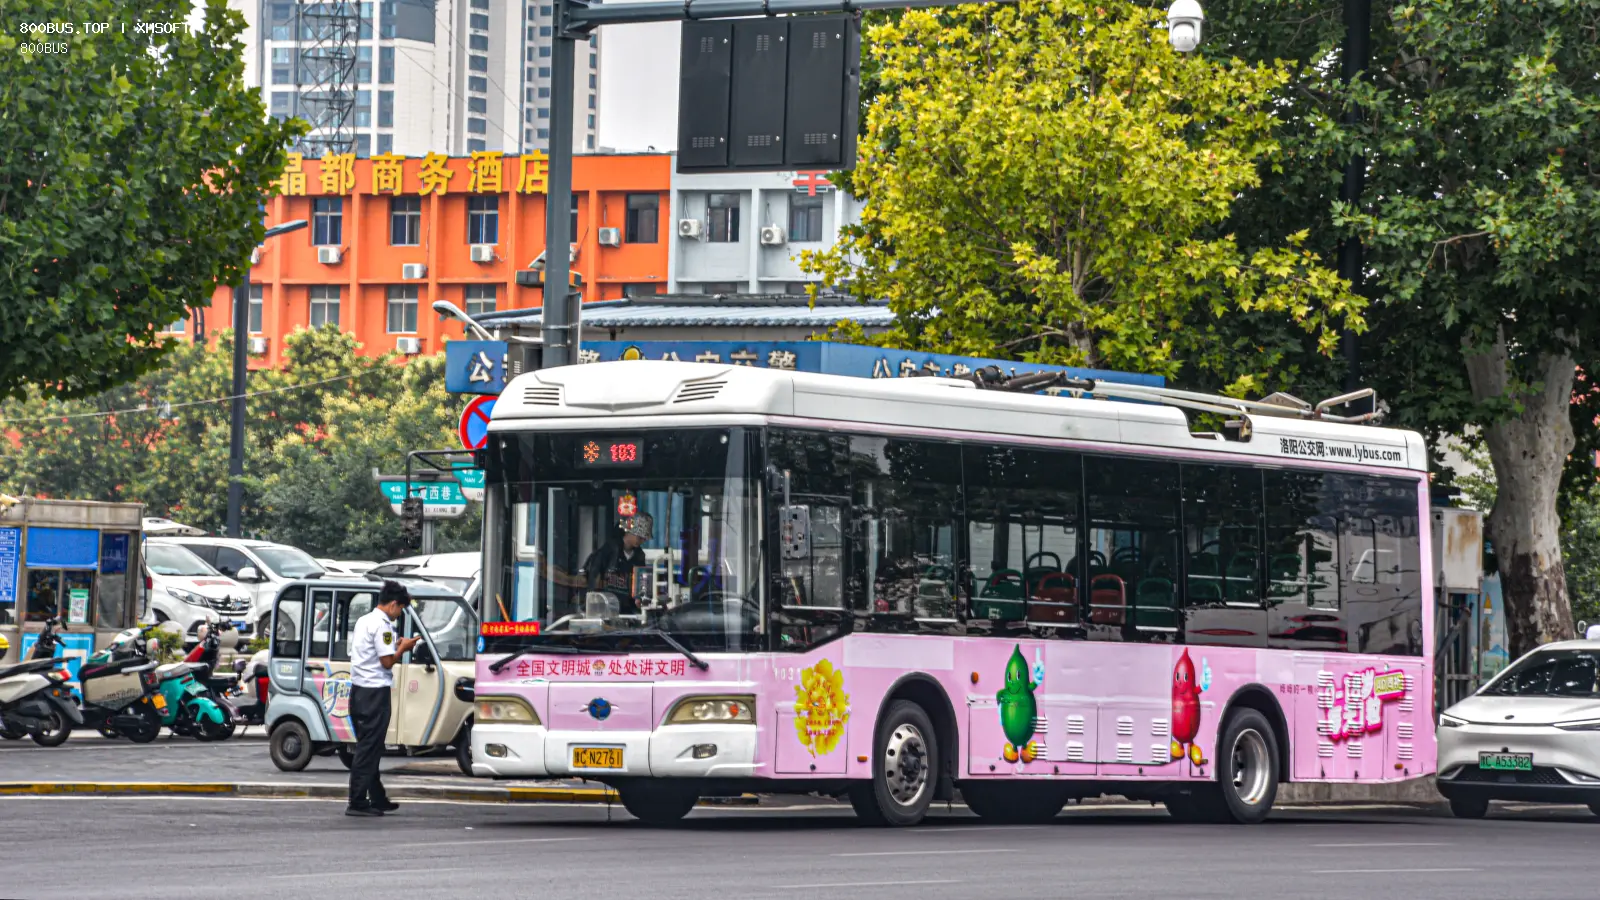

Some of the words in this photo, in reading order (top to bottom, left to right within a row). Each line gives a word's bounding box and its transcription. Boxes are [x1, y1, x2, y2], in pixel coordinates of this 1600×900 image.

[610, 444, 637, 462] 103
[516, 659, 591, 677] 全国文明城
[608, 659, 686, 677] 处处讲文明
